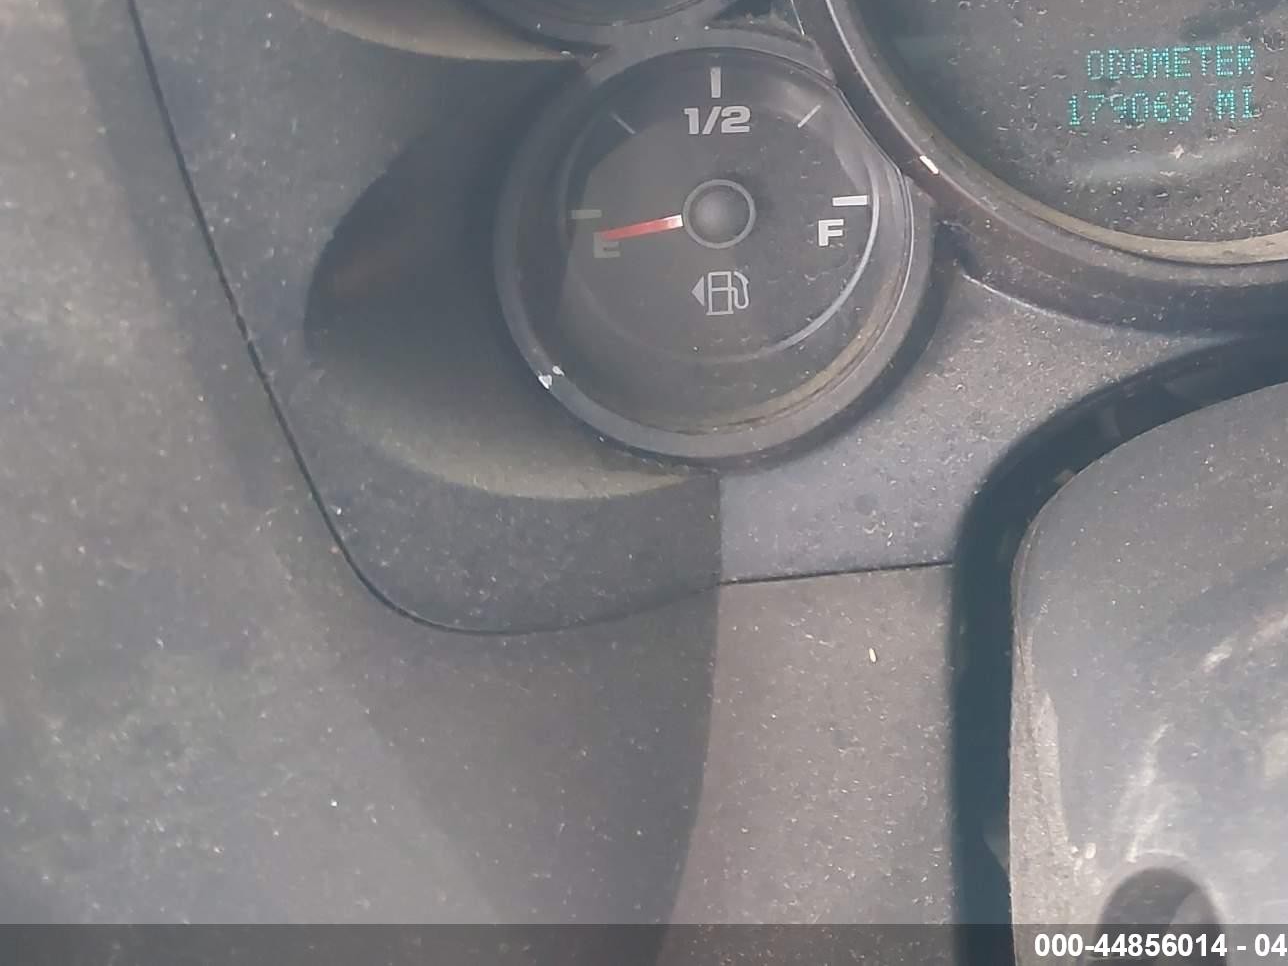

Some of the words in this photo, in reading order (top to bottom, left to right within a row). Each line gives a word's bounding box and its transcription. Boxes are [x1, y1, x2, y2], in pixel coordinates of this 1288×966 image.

[1087, 45, 1255, 80] ODOMETER
[684, 106, 751, 135] 1/2
[1068, 91, 1193, 126] 179068
[1217, 88, 1255, 120] MI
[593, 232, 621, 259] E
[818, 219, 845, 247] F
